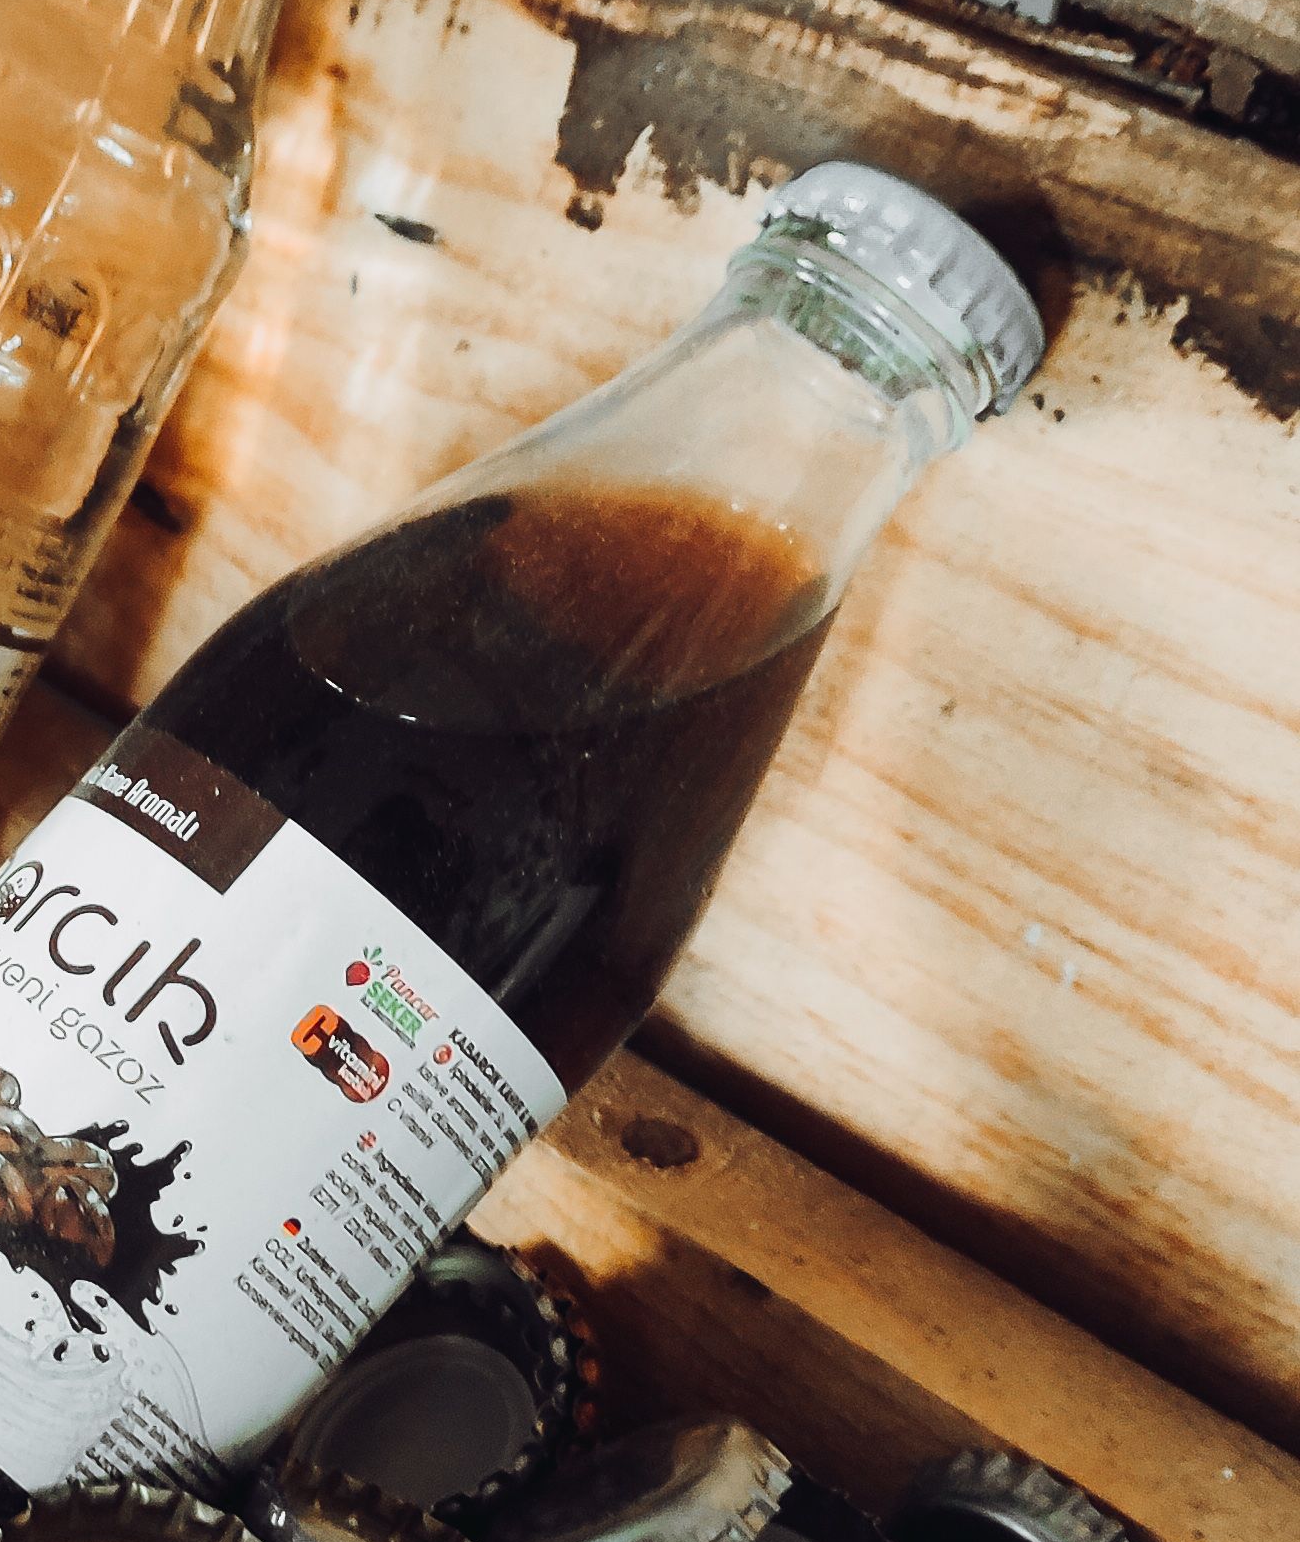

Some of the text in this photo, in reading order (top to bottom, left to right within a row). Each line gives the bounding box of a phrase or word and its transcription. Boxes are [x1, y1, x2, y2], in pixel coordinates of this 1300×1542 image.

[124, 778, 200, 842] Aromalı
[381, 964, 440, 1023] Pancar
[49, 1007, 166, 1105] gazoz
[290, 1004, 339, 1056] C
[329, 1034, 386, 1091] vitamini
[387, 1097, 402, 1113] C
